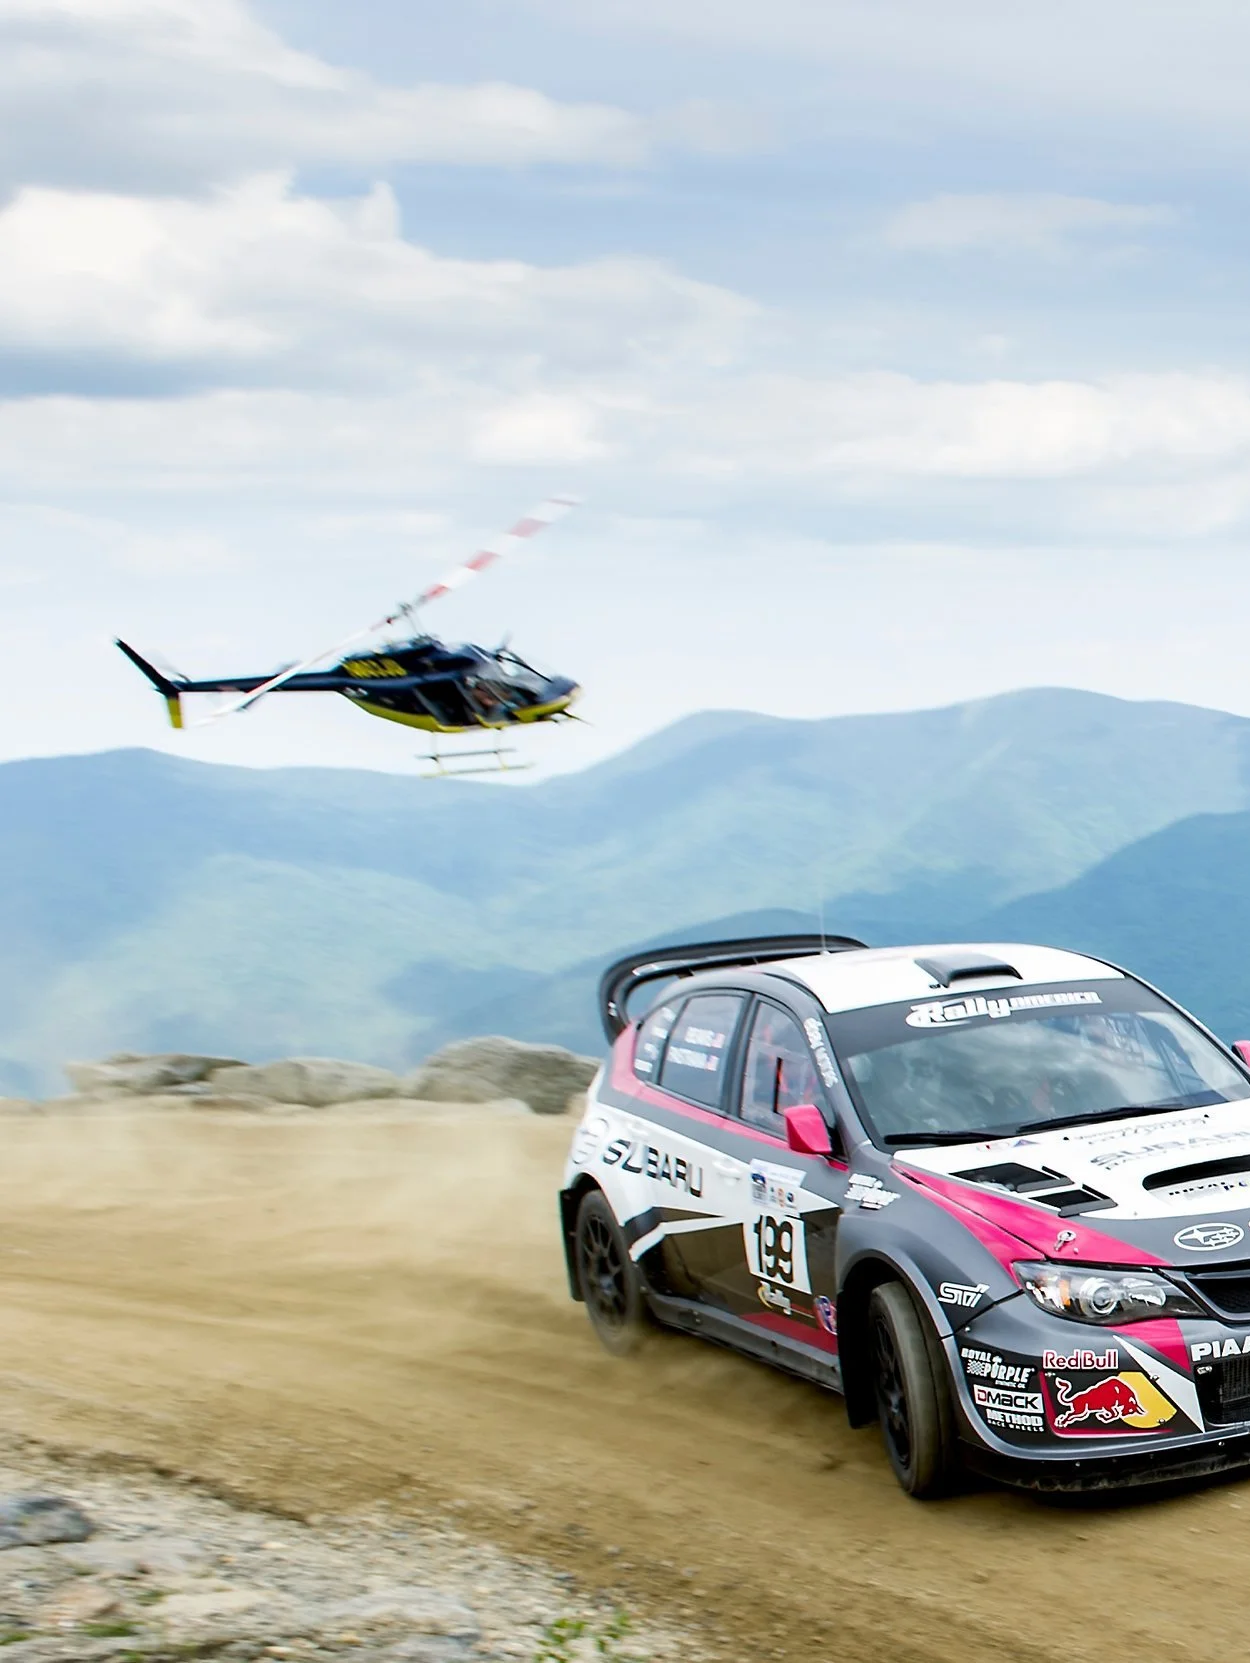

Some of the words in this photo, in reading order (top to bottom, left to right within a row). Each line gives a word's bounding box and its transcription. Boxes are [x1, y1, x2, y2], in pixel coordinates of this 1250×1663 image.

[909, 996, 1011, 1022] Rally
[603, 1139, 702, 1198] SUBARU
[753, 1214, 793, 1284] 199
[961, 1347, 992, 1363] ROYAL
[1042, 1349, 1081, 1370] Red
[1081, 1349, 1119, 1370] Bull
[986, 1408, 1043, 1427] METHOD
